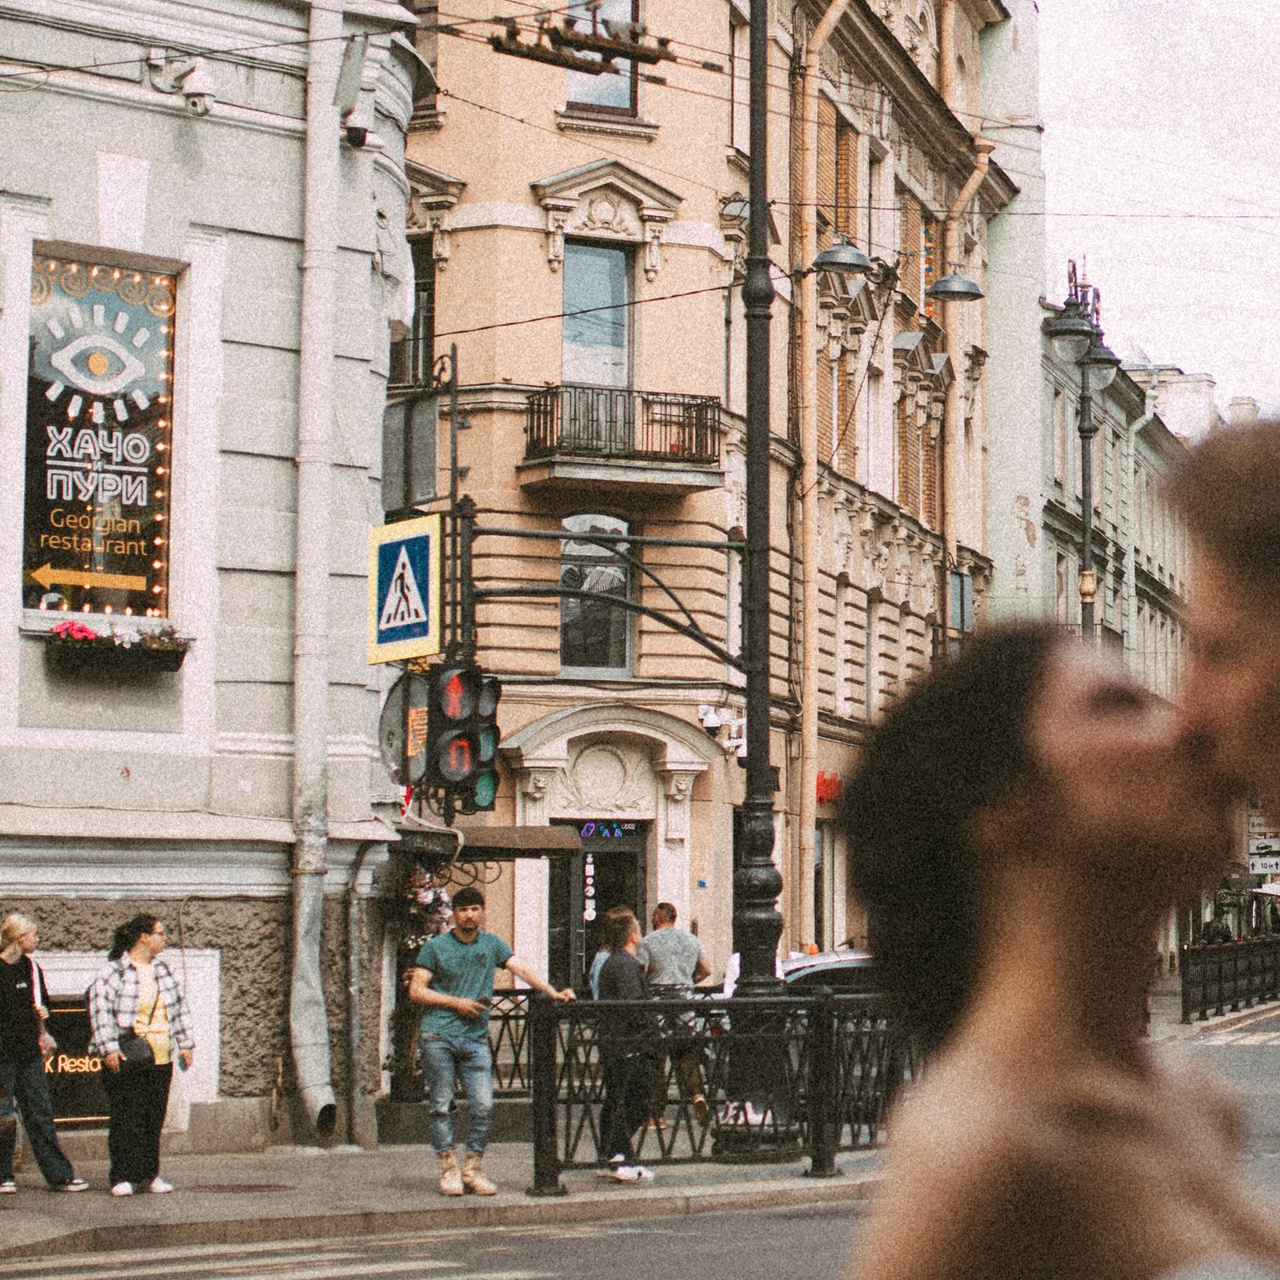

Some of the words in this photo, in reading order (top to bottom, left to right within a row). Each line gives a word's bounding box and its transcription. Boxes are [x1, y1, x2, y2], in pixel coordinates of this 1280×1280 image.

[46, 425, 150, 464] ХАЧО
[46, 469, 148, 507] ПУРИ
[50, 508, 140, 535] Georgian
[40, 533, 148, 556] restaurant
